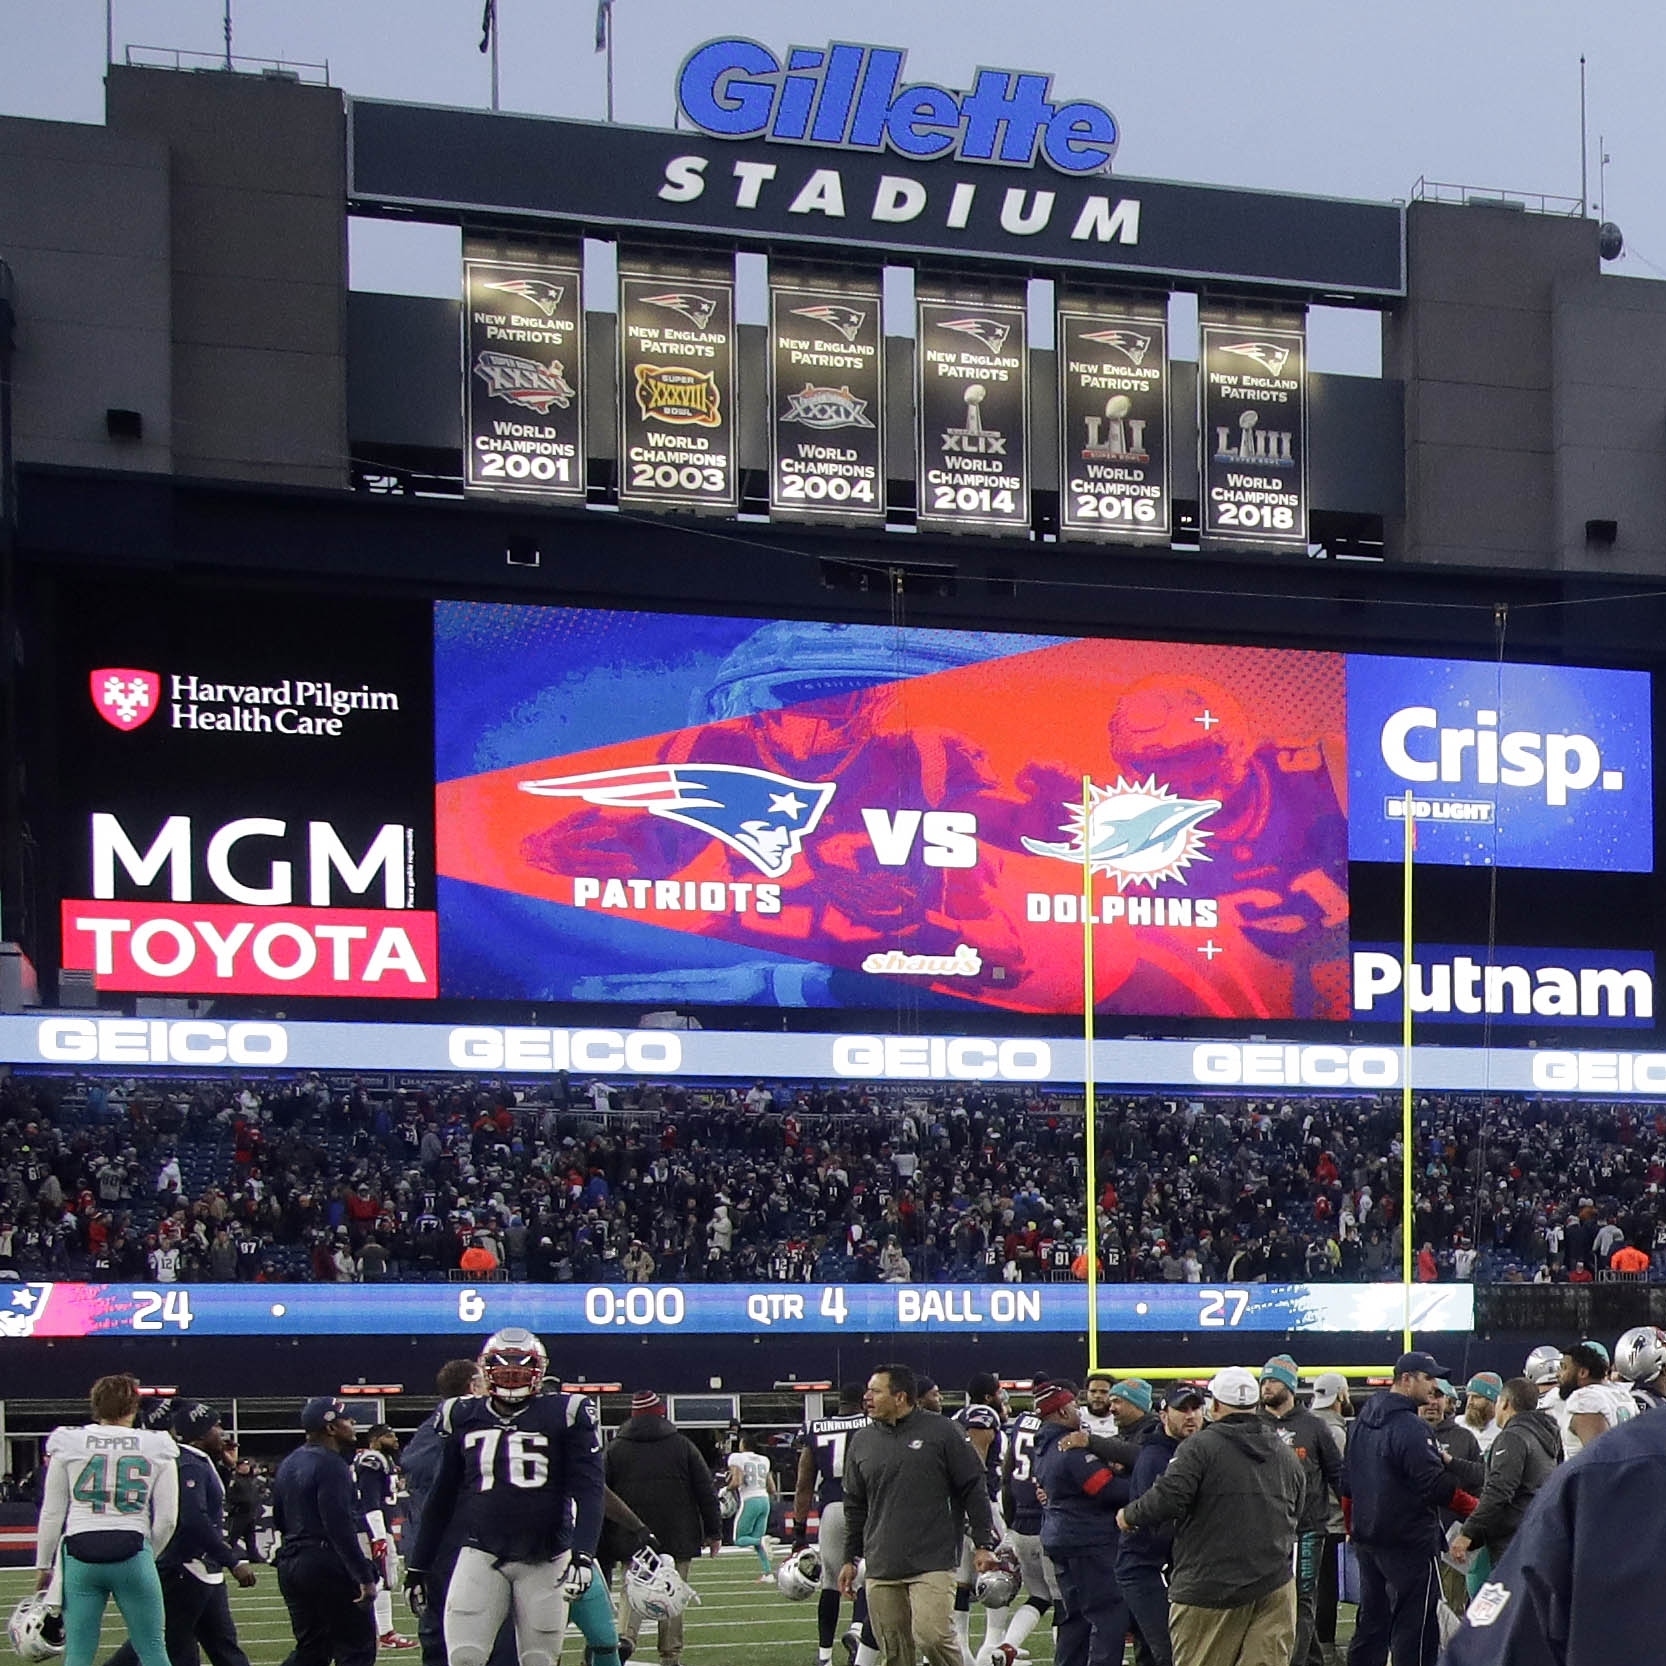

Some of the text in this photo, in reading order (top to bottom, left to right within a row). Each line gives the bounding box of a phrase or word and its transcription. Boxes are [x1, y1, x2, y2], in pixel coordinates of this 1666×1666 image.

[677, 36, 1119, 175] Gillette
[659, 156, 1140, 245] STADIUM
[511, 314, 574, 331] ENGLAND
[486, 327, 563, 345] PATRIOTS
[664, 328, 726, 344] ENGLAND
[640, 339, 715, 358] PATRIOTS
[814, 341, 875, 356] ENGLAND
[791, 351, 863, 369] PATRIOTS
[961, 352, 1019, 368] ENGLAND
[937, 363, 1009, 381] PATRIOTS
[1103, 363, 1160, 380] ENGLAND
[1242, 374, 1298, 390] ENGLAND
[1081, 374, 1150, 391] PATRIOTS
[1221, 386, 1288, 403] PATRIOTS
[493, 421, 556, 440] WORLD
[475, 436, 576, 457] CHAMPIONS
[647, 432, 709, 451] WORLD
[941, 434, 1008, 455] XLIX
[629, 447, 727, 467] CHAMPIONS
[797, 444, 858, 462] WORLD
[481, 454, 570, 482] 2001
[780, 458, 876, 478] CHAMPIONS
[944, 455, 1004, 473] WORLD
[1087, 465, 1144, 482] WORLD
[632, 464, 725, 492] 2003
[928, 470, 1020, 490] CHAMPIONS
[1071, 479, 1160, 498] CHAMPIONS
[1227, 473, 1283, 491] WORLD
[782, 475, 875, 503] 2004
[1211, 488, 1298, 507] CHAMPIONS
[933, 487, 1015, 514] 2014
[1076, 494, 1156, 522] 2016
[1218, 504, 1294, 529] 2018
[171, 673, 400, 717] Harvard Pilgrim
[171, 703, 343, 737] Health Care
[1381, 706, 1624, 806] Crisp.
[862, 808, 978, 868] VS
[91, 811, 405, 910] MGM
[574, 877, 782, 914] PATRIOTS
[1026, 892, 1219, 928] DOLPHINS
[76, 917, 427, 983] TOYOTA
[1353, 952, 1653, 1018] Putnam
[38, 1019, 288, 1065] GEICO
[448, 1027, 682, 1073] GEICO
[832, 1036, 1052, 1080] GEICO
[1193, 1043, 1399, 1086] GEICO
[132, 1286, 1250, 1330] 24 & 0:00 QTR 4 BALL ON 27
[86, 1435, 141, 1450] PEPPER
[464, 1429, 550, 1491] 76
[73, 1454, 152, 1516] 46
